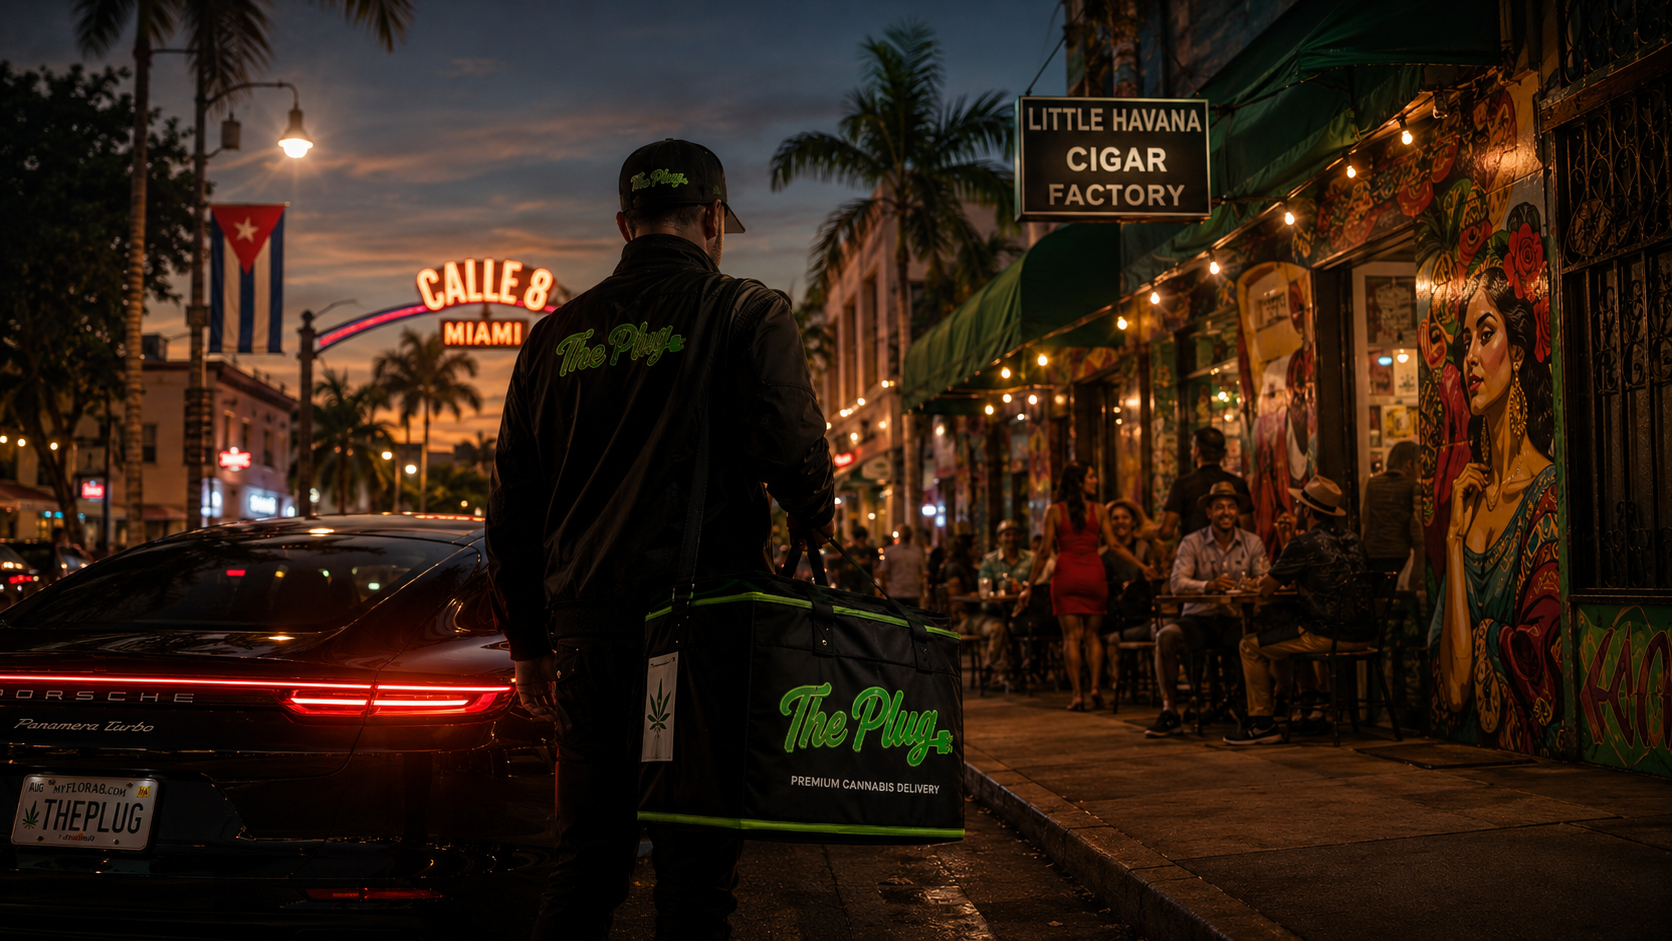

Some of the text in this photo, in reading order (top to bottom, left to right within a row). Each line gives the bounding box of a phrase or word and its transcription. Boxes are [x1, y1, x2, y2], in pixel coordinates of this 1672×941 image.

[1028, 107, 1202, 132] LITTLE HAVANA
[1066, 146, 1168, 173] CIGAR
[1049, 183, 1186, 207] FACTORY
[416, 258, 554, 312] CALLE 8
[444, 321, 523, 346] MIAMI
[555, 320, 675, 377] The Plug
[0, 689, 195, 703] ORSCHE
[13, 718, 155, 733] Panamera Turbo
[779, 681, 941, 767] The Plug
[28, 782, 44, 793] AUG
[791, 775, 940, 795] PREMIUM CANNABIS DELIVERY
[42, 798, 144, 834] THEPLUG
